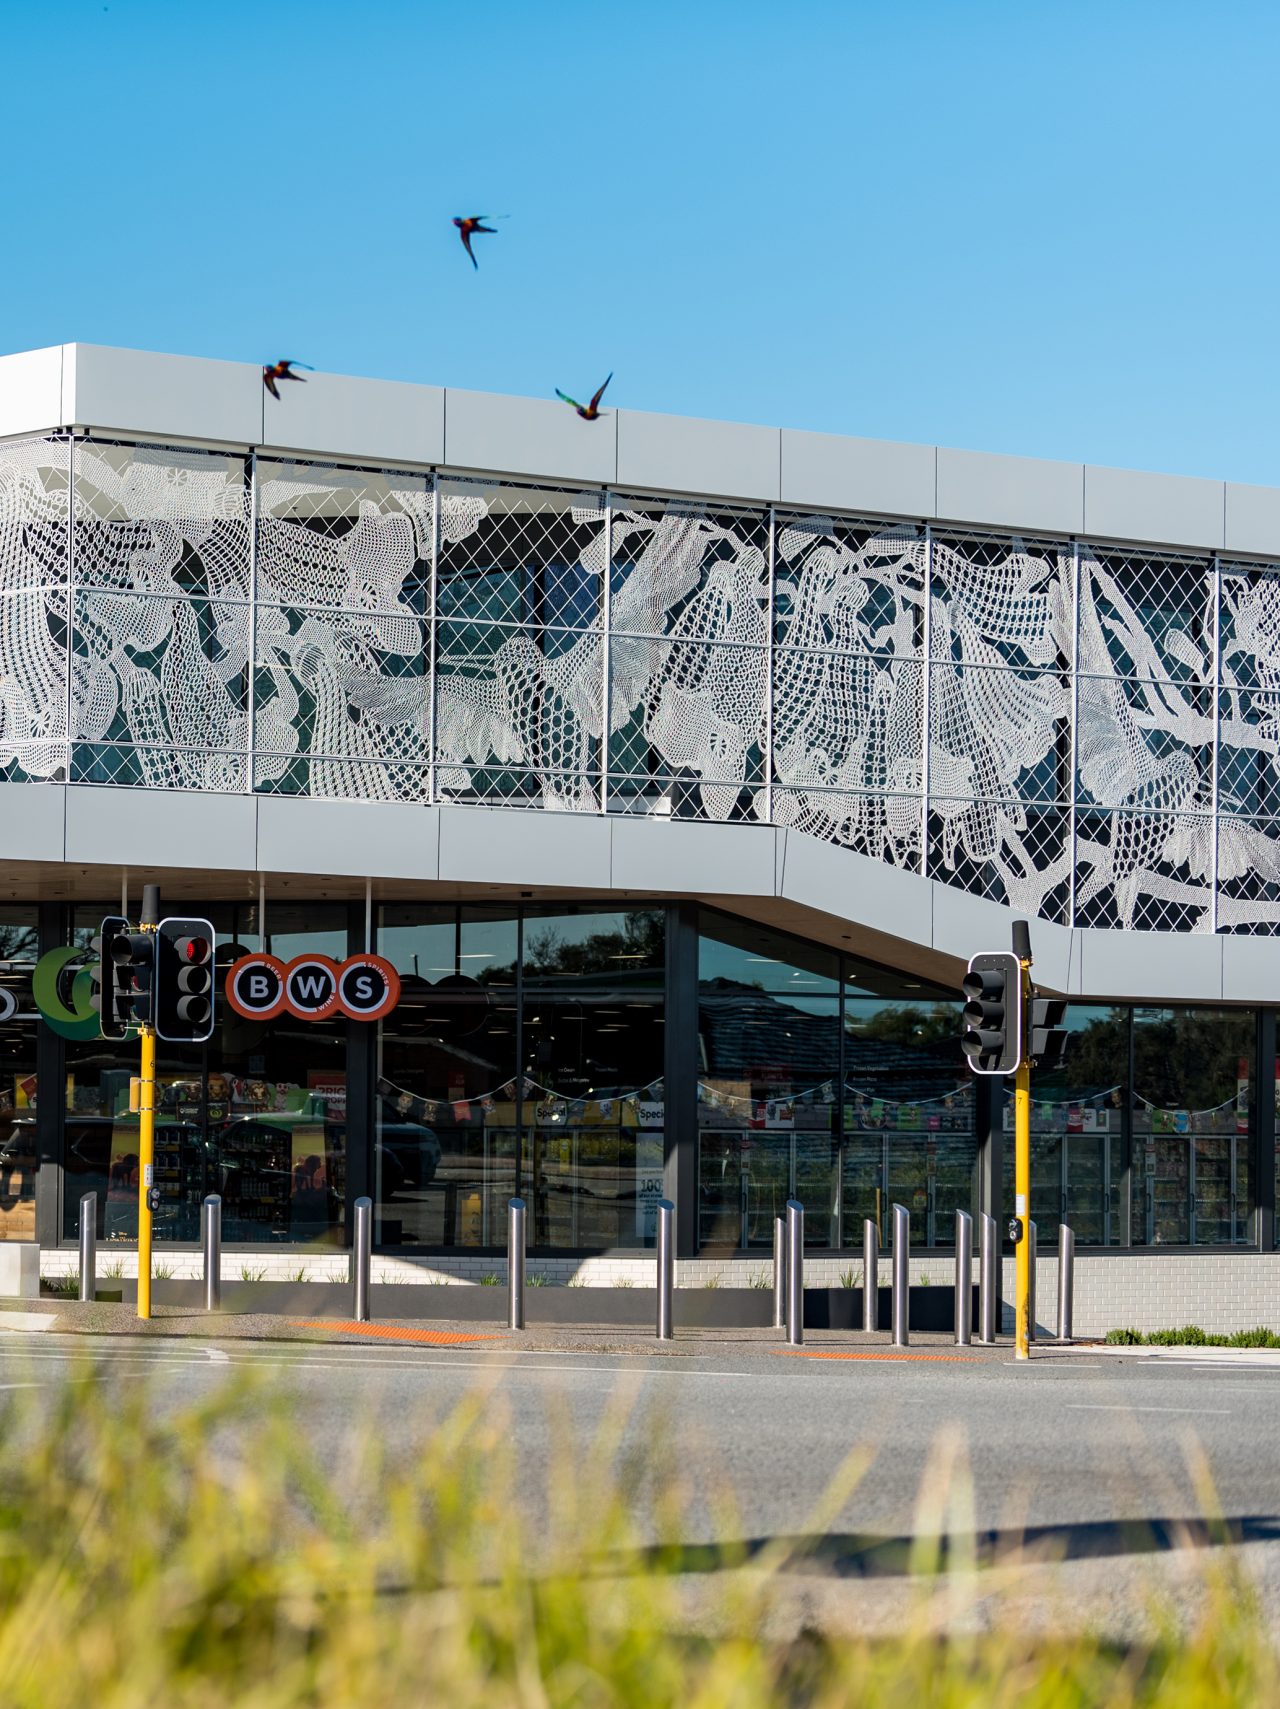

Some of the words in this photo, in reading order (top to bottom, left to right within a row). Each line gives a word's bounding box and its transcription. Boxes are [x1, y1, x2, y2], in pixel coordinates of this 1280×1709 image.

[266, 963, 282, 980] BEER
[366, 962, 390, 986] SPIRITS
[318, 994, 336, 1012] WINE
[319, 1087, 346, 1096] PRIC
[1017, 1097, 1023, 1105] 7
[640, 1109, 664, 1121] Speci
